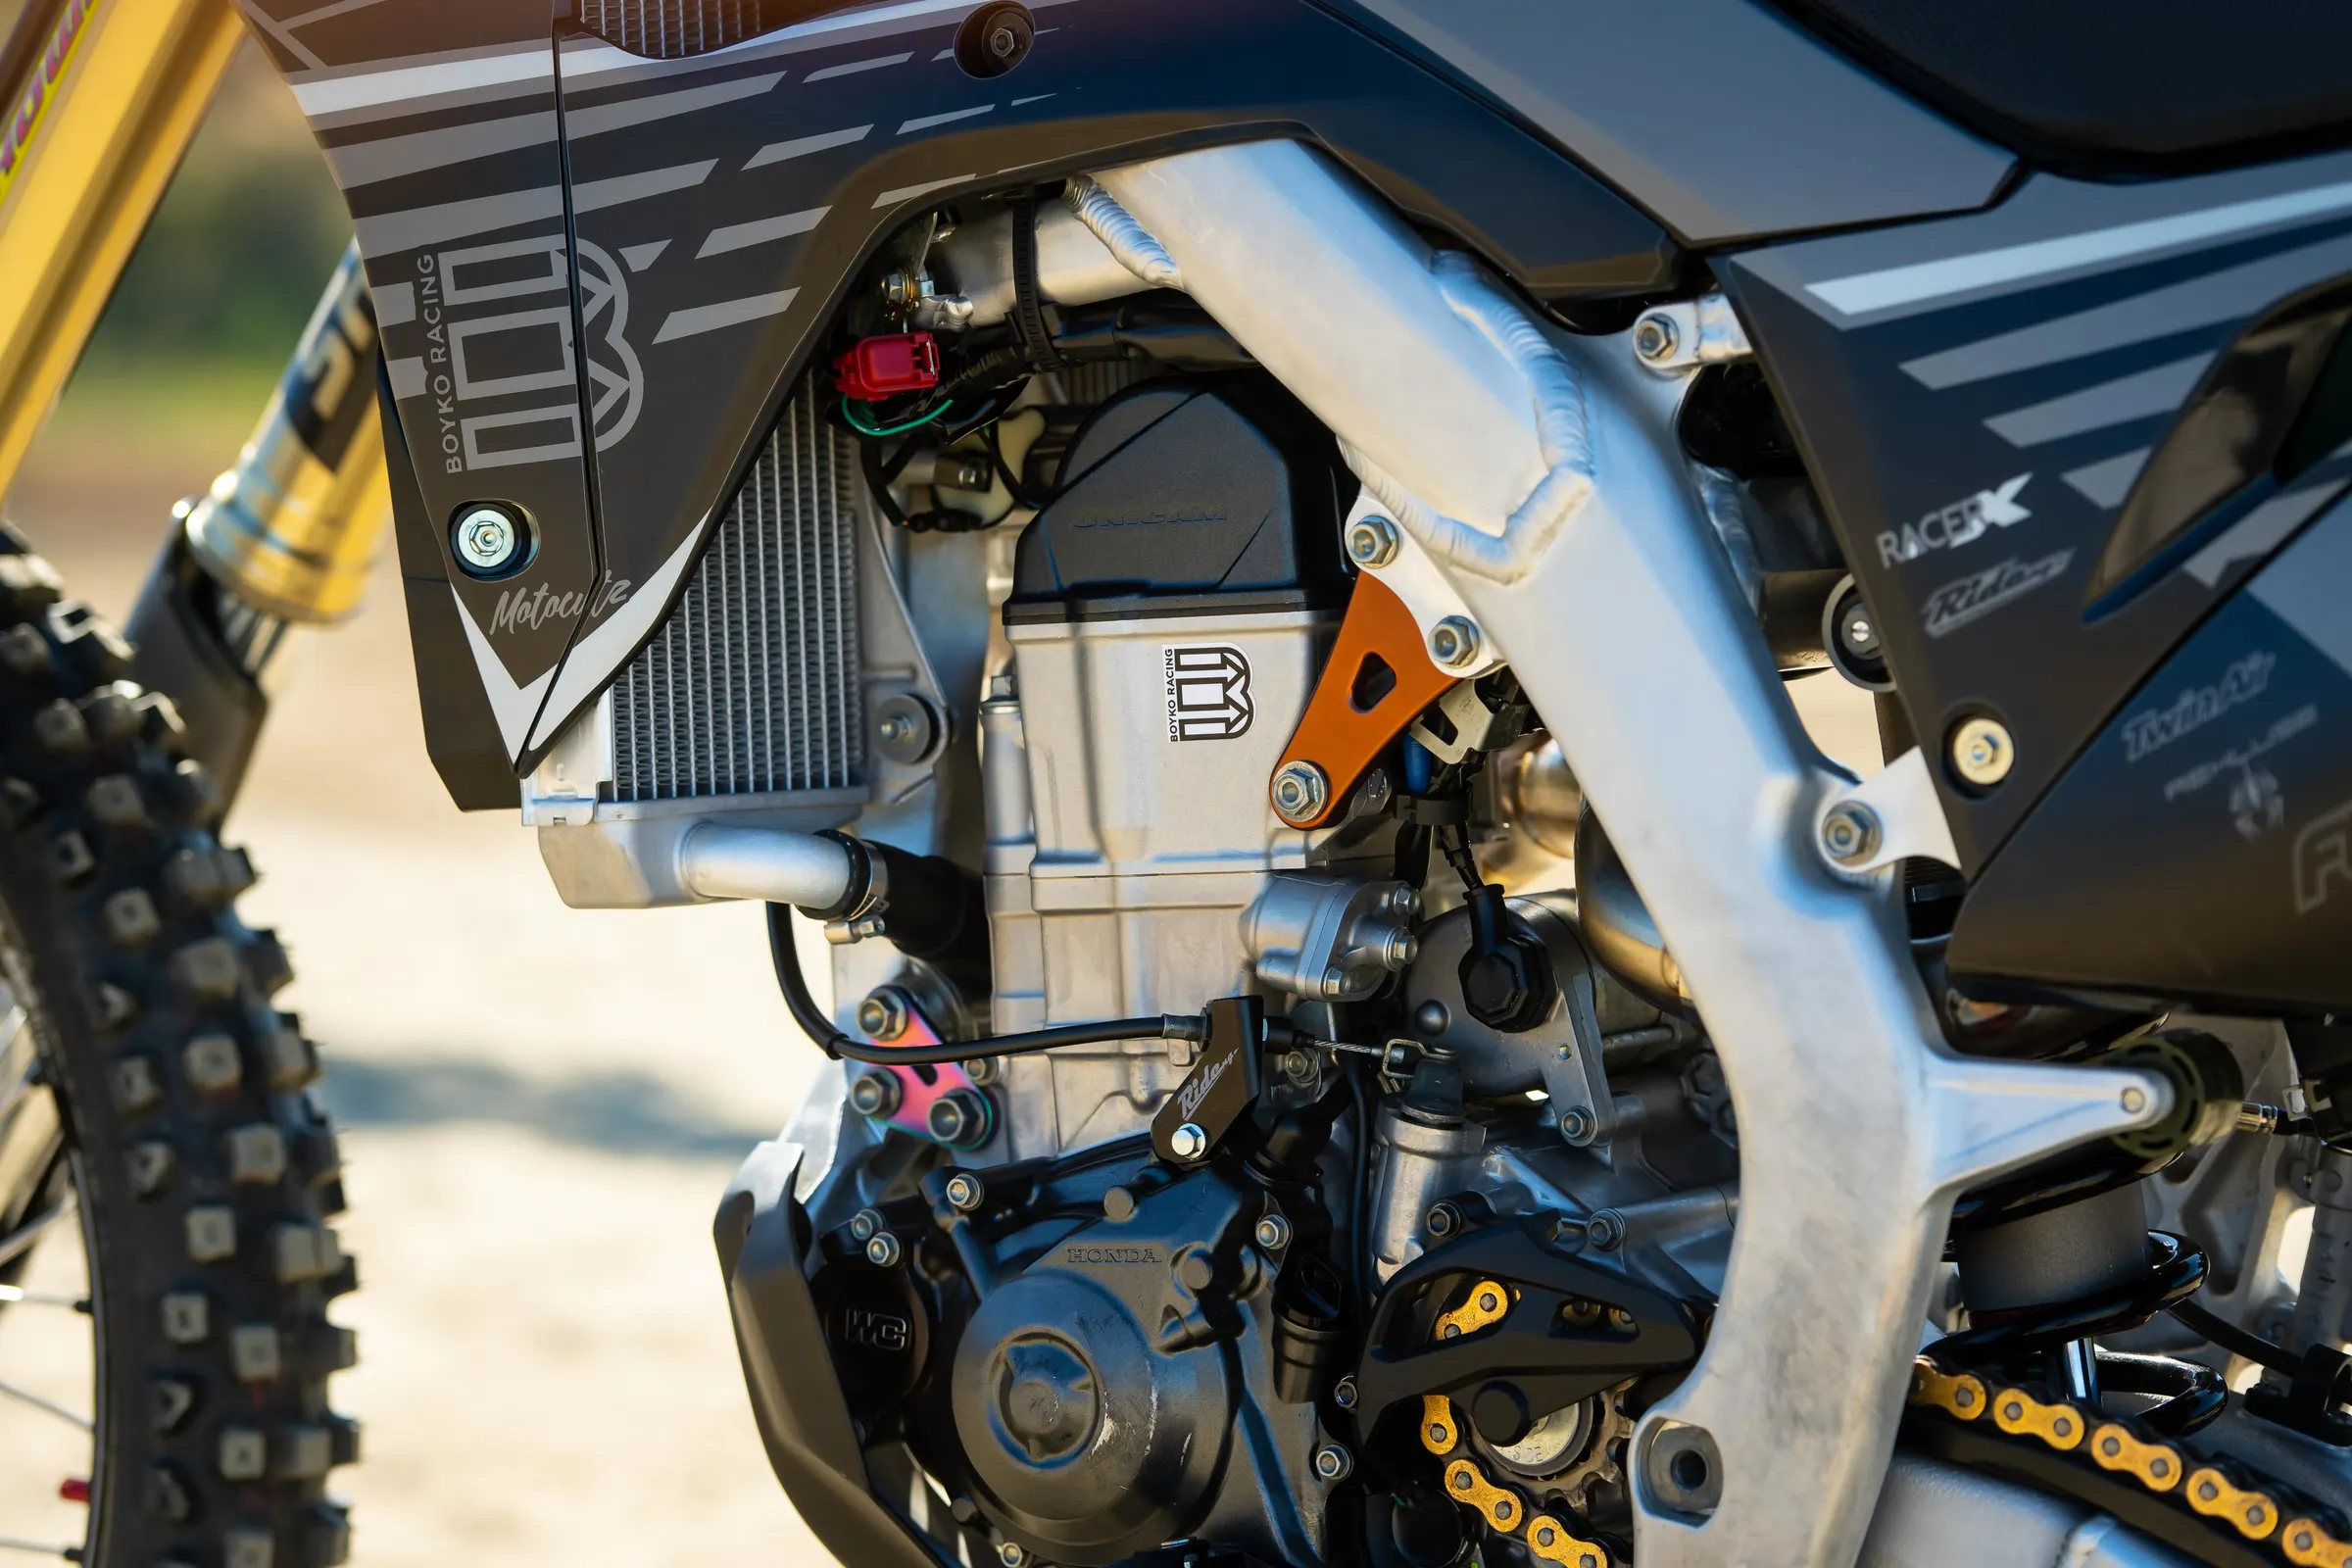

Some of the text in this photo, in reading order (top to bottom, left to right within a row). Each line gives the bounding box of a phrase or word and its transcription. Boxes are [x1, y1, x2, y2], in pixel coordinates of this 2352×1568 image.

[416, 253, 464, 474] BOYKO RACING
[1164, 648, 1179, 743] BOYKO RACING
[1066, 1248, 1163, 1264] HONDA
